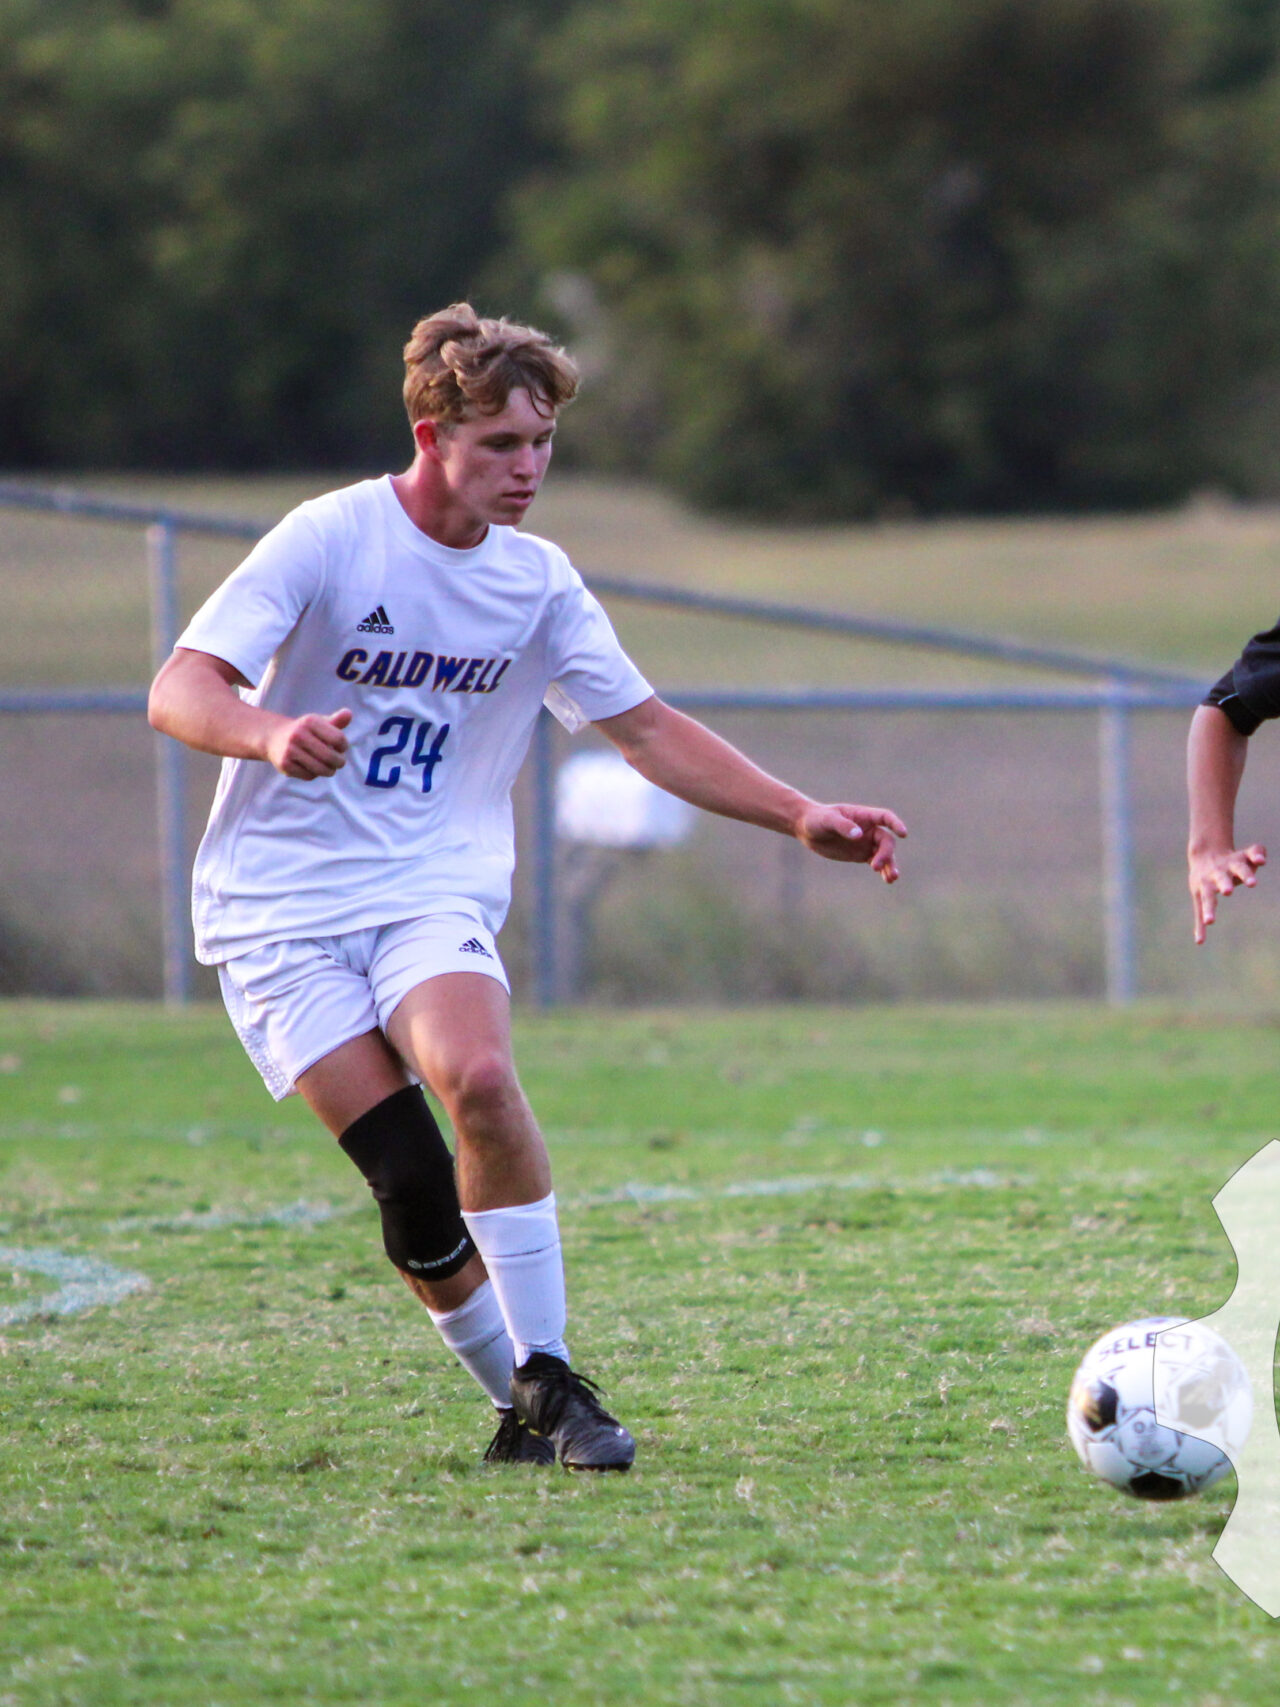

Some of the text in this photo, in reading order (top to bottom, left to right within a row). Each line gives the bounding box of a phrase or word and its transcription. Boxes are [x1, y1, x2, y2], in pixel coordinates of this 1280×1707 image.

[356, 623, 394, 635] adidas
[336, 648, 512, 693] CALDWELL
[364, 715, 450, 793] 24
